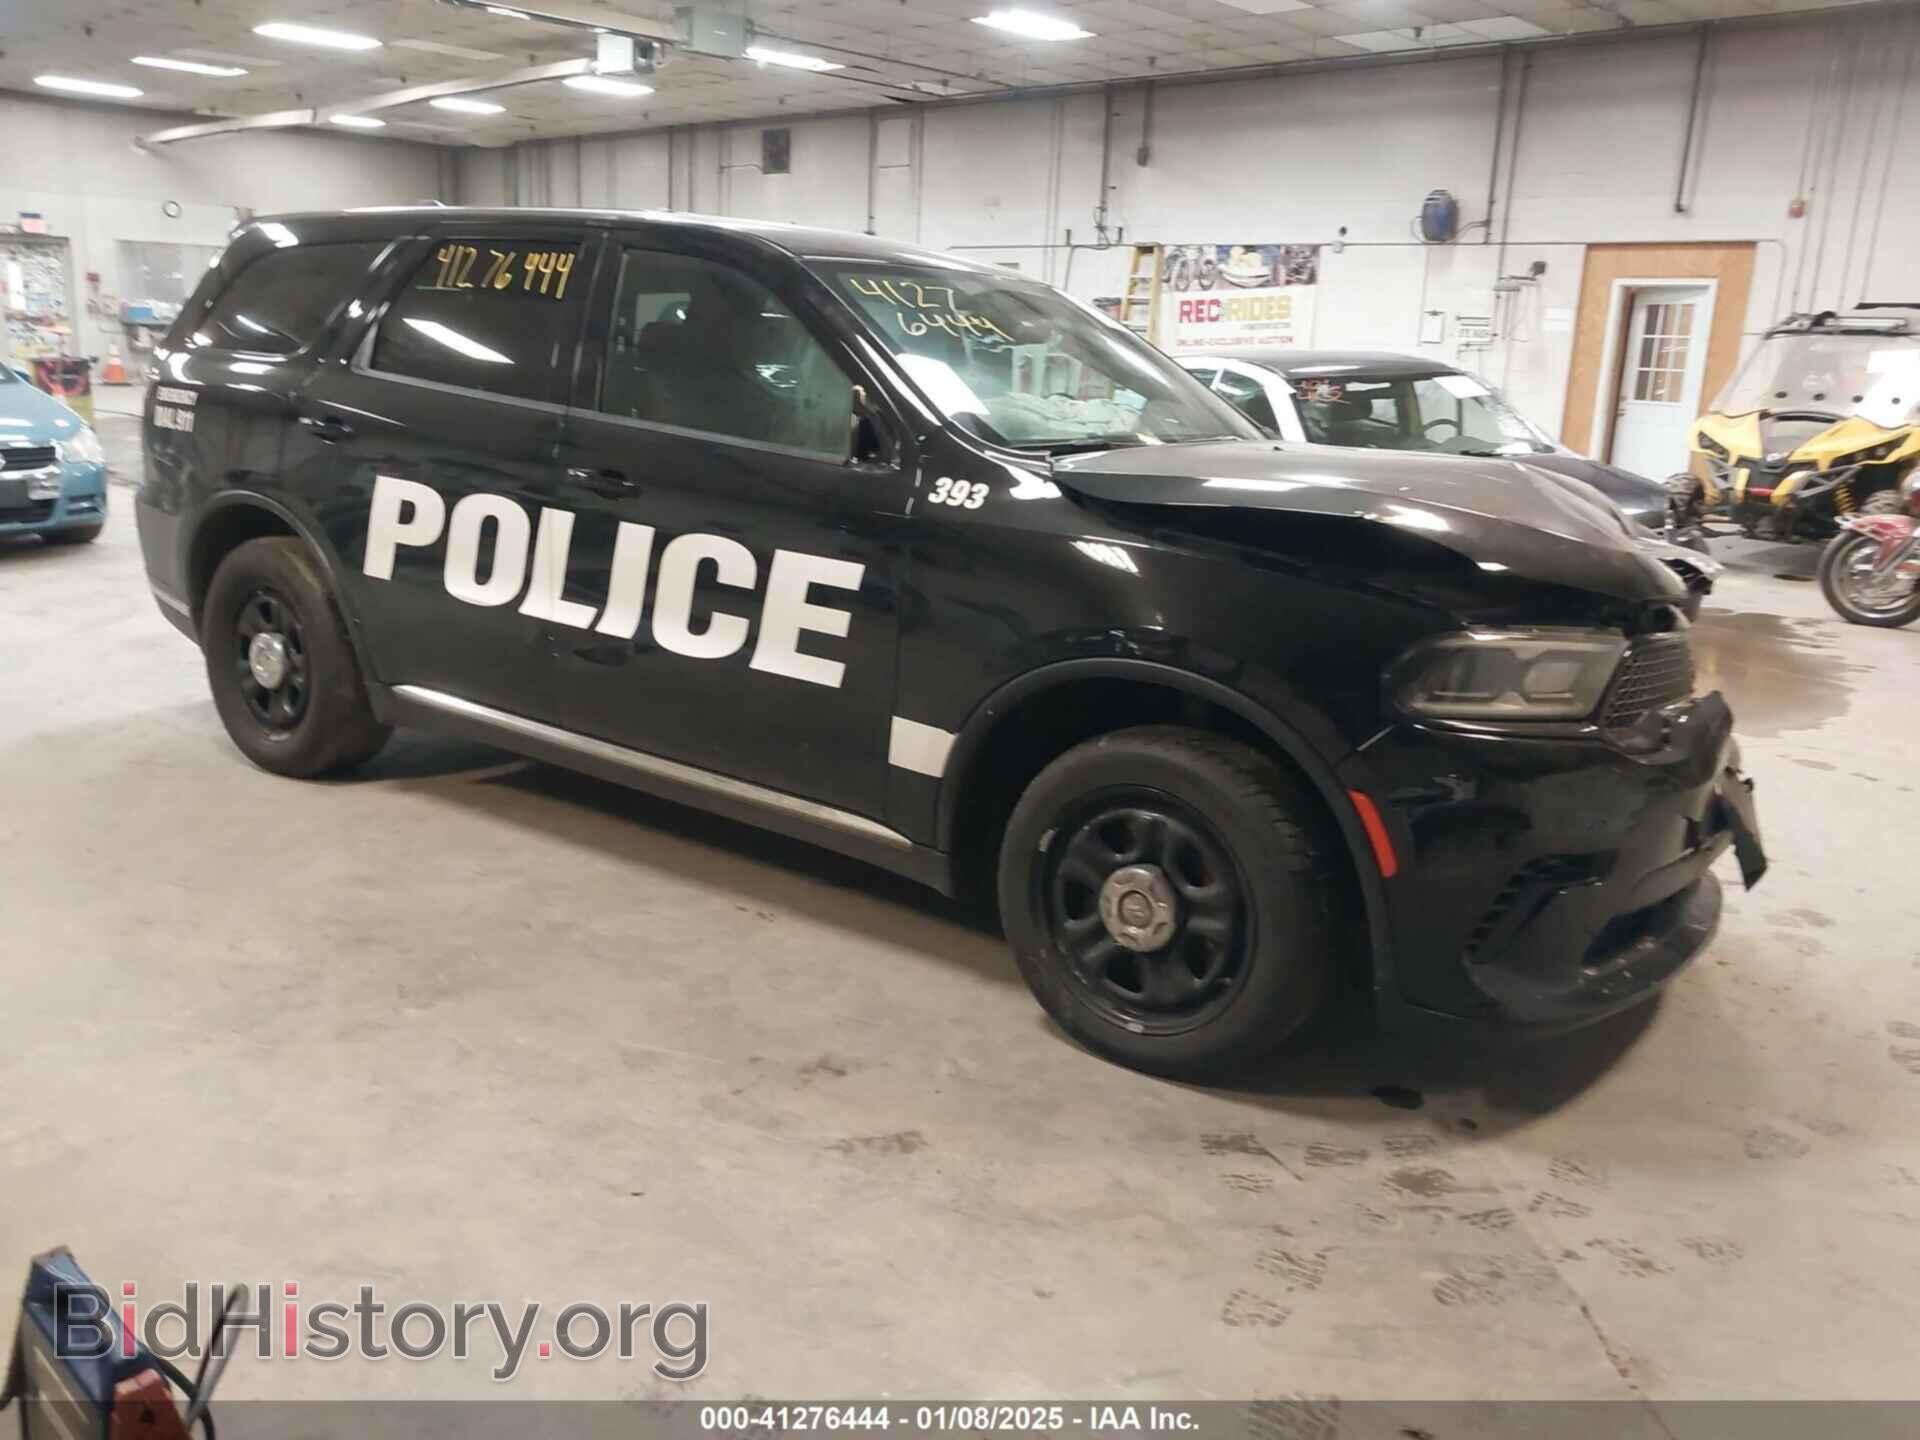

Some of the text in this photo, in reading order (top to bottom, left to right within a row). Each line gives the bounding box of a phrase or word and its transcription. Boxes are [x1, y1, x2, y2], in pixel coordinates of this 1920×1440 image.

[481, 249, 517, 290] 76
[524, 251, 576, 300] 444
[849, 278, 964, 316] 4127
[927, 476, 990, 510] 393
[362, 474, 866, 689] POLICE
